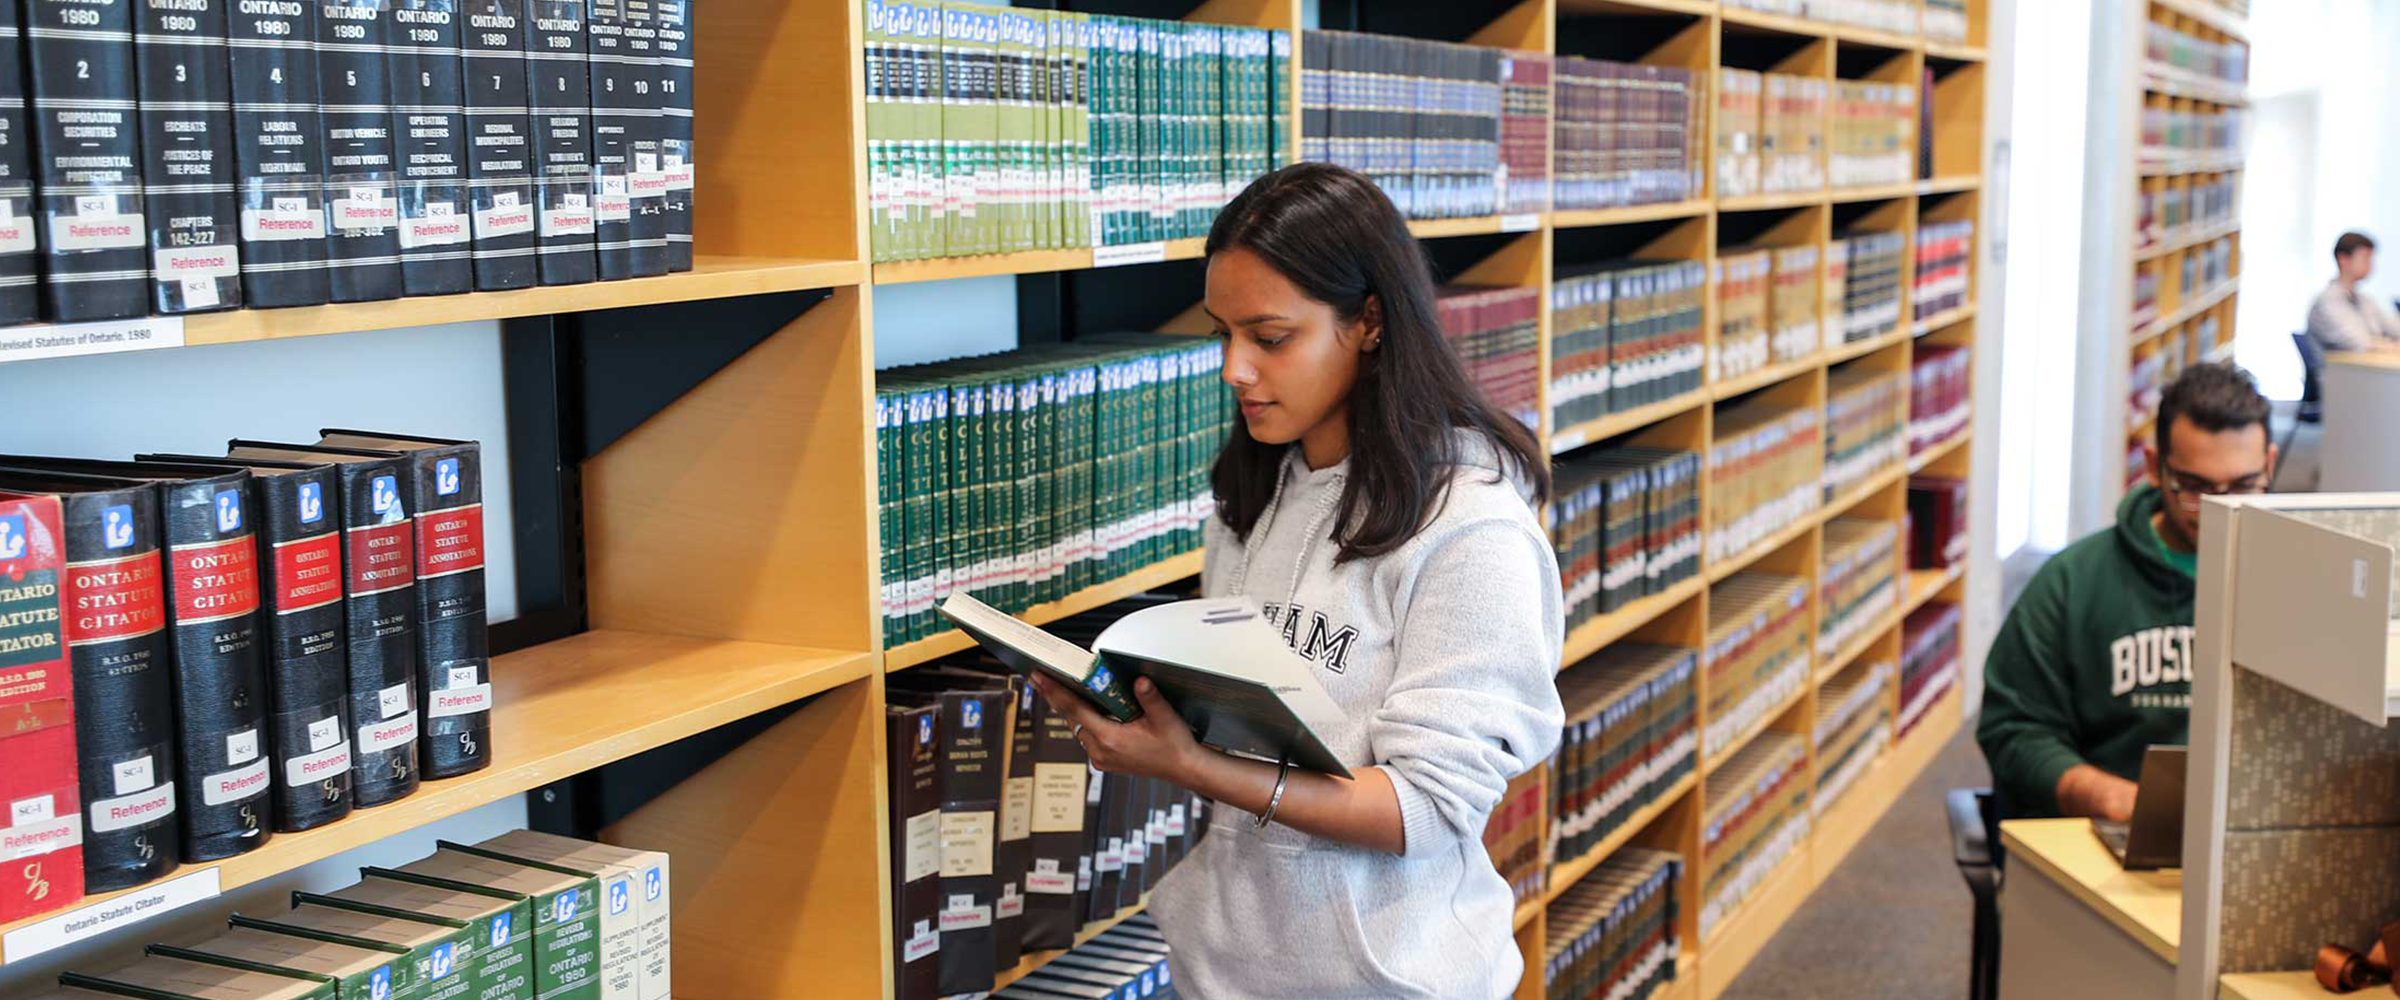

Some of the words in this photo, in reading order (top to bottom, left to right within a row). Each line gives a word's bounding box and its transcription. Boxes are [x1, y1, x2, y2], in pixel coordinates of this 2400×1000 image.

[150, 0, 208, 12] ONTARIO
[240, 1, 302, 16] ONTARIO
[324, 6, 378, 20] ONTARIO
[60, 9, 100, 25] 1980
[160, 16, 196, 31] 1980
[396, 10, 450, 24] ONTARIO
[470, 16, 516, 28] ONTARIO
[254, 21, 290, 35] 1980
[334, 26, 366, 38] 1980
[538, 18, 580, 32] ONTARIO
[590, 25, 622, 36] ONTARIO
[408, 29, 439, 42] 1980
[481, 34, 508, 46] 1980
[624, 28, 656, 38] ONTARIO
[547, 36, 572, 48] 1980
[598, 38, 618, 48] 1980
[630, 40, 650, 50] 1980
[659, 42, 678, 51] 1980
[77, 61, 90, 78] 2
[175, 65, 187, 82] 3
[270, 68, 283, 84] 4
[346, 70, 356, 86] 5
[422, 72, 431, 87] 6
[492, 76, 501, 90] 7
[558, 77, 566, 92] 8
[606, 78, 614, 92] 9
[634, 81, 648, 94] 10
[662, 80, 676, 94] 11
[57, 112, 122, 124] CORPORATION
[64, 126, 117, 138] SECURITIES
[164, 121, 207, 132] ESCHEATS
[262, 122, 298, 132] LABOUR
[354, 128, 388, 138] VEHICLE
[410, 128, 450, 138] ENGINEERS
[258, 135, 304, 145] RELATIONS
[56, 156, 133, 168] ENVIRONMENTAL
[163, 150, 200, 162] JUSTICES
[202, 150, 213, 160] OF
[362, 154, 389, 164] YOUTH
[186, 164, 211, 174] PEACE
[345, 207, 394, 218] Reference
[170, 216, 214, 228] CHAPTERS
[259, 218, 314, 230] Reference
[488, 214, 528, 227] Reference
[554, 216, 590, 227] Reference
[69, 225, 131, 238] Reference
[414, 224, 460, 236] Reference
[170, 232, 215, 245] 142-227
[171, 257, 224, 268] Reference
[35, 334, 75, 348] Statutes
[78, 333, 86, 344] of
[128, 329, 152, 340] 1980
[434, 520, 468, 532] ONTARIO
[368, 536, 401, 549] ONTARIO
[435, 534, 468, 548] STATUTE
[296, 548, 329, 564] ONTARIO
[368, 551, 402, 564] STATUTE
[428, 548, 476, 564] ANNOTATIONS
[76, 566, 156, 588] ONTARIO
[192, 568, 252, 590] STATUT
[296, 564, 330, 580] STATUTE
[0, 584, 56, 602] TARIO
[78, 587, 156, 609] STATUTE
[193, 588, 252, 610] CITATO
[80, 606, 157, 630] CITATOR
[0, 682, 46, 697] EDITION
[110, 796, 168, 820] Reference
[4, 826, 70, 848] Reference
[64, 916, 98, 934] Ontario
[100, 904, 132, 922] Statute
[135, 894, 166, 912] Citator
[556, 922, 584, 938] REVISED
[548, 930, 592, 952] REGULATIONS
[486, 946, 514, 964] REVISED
[548, 951, 594, 975] ONTARIO
[558, 968, 586, 984] 1980
[481, 976, 524, 1000] ONTARIO
